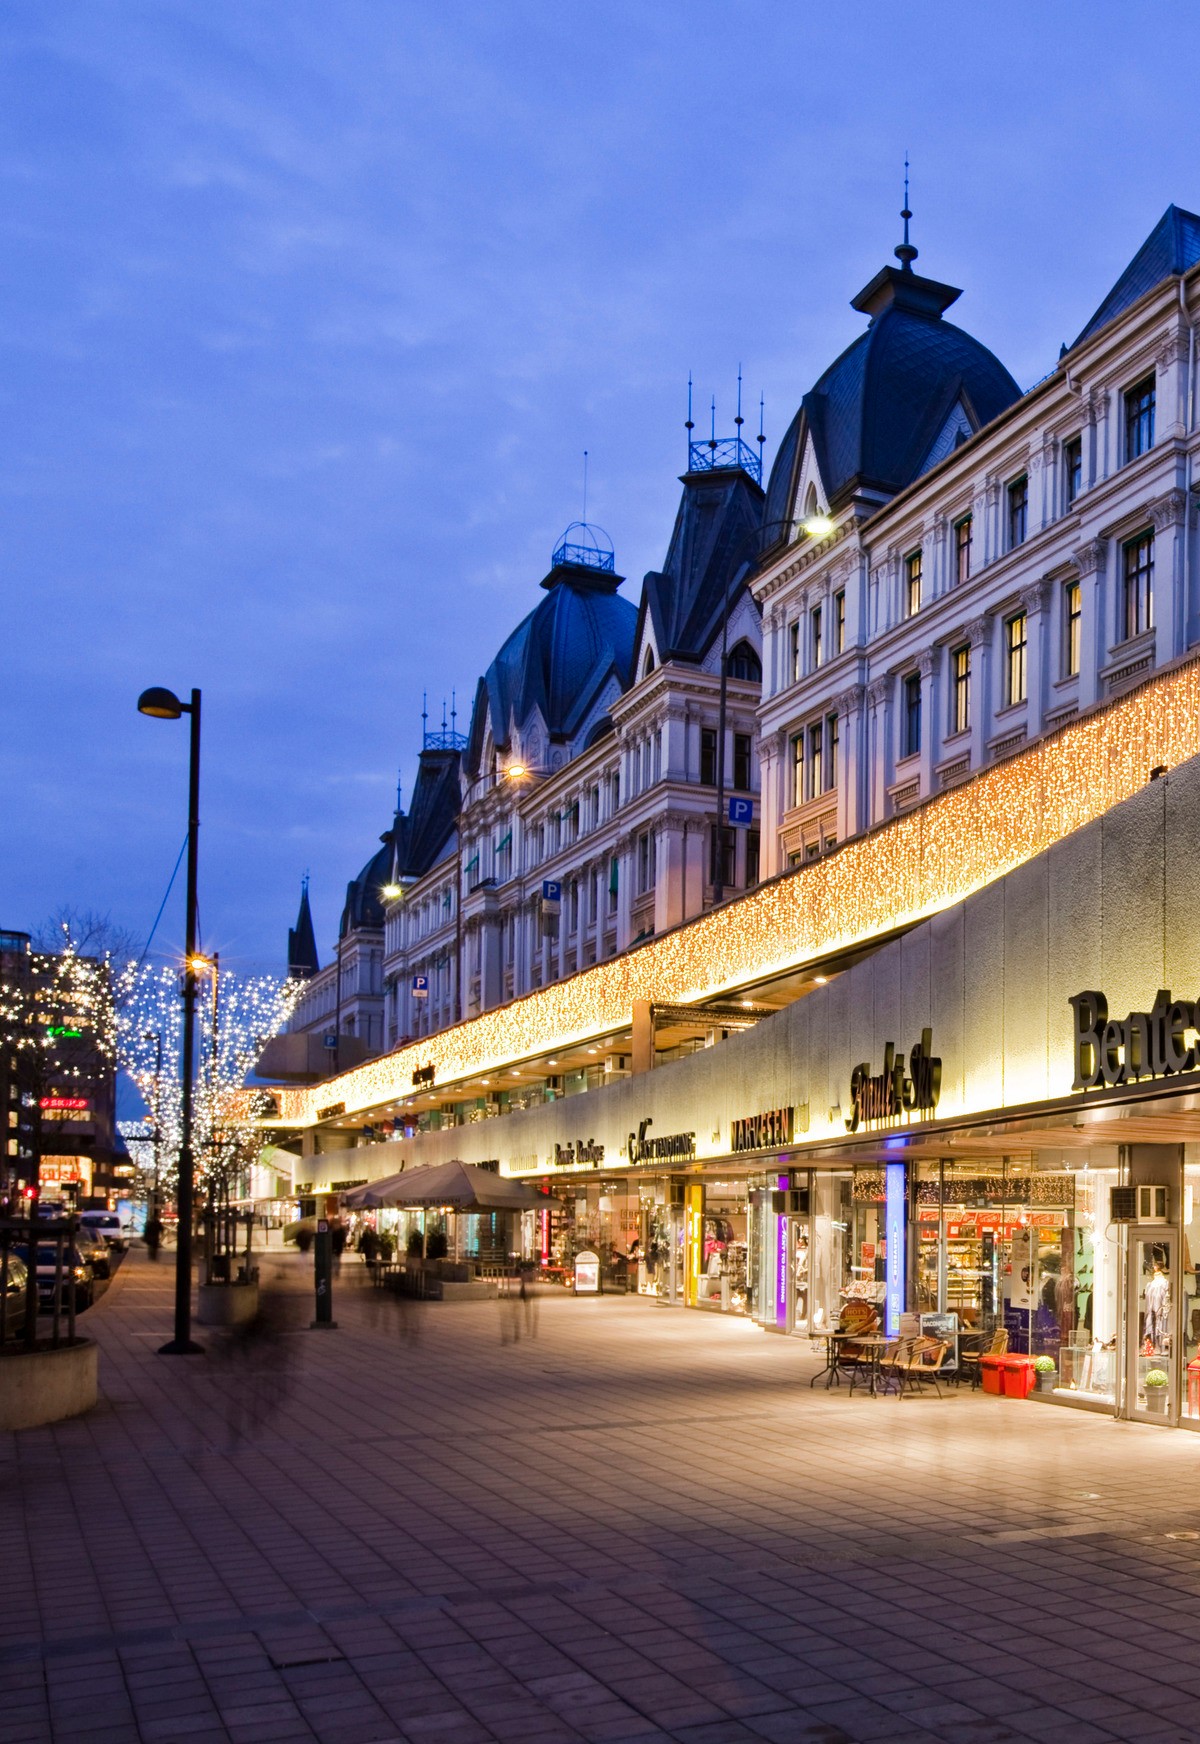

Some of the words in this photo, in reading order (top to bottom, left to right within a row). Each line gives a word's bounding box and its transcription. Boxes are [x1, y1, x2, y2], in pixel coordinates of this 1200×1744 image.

[735, 801, 748, 819] P
[547, 883, 557, 898] P
[416, 977, 425, 989] P
[326, 1036, 334, 1046] P
[731, 1107, 794, 1152] NARVESEN
